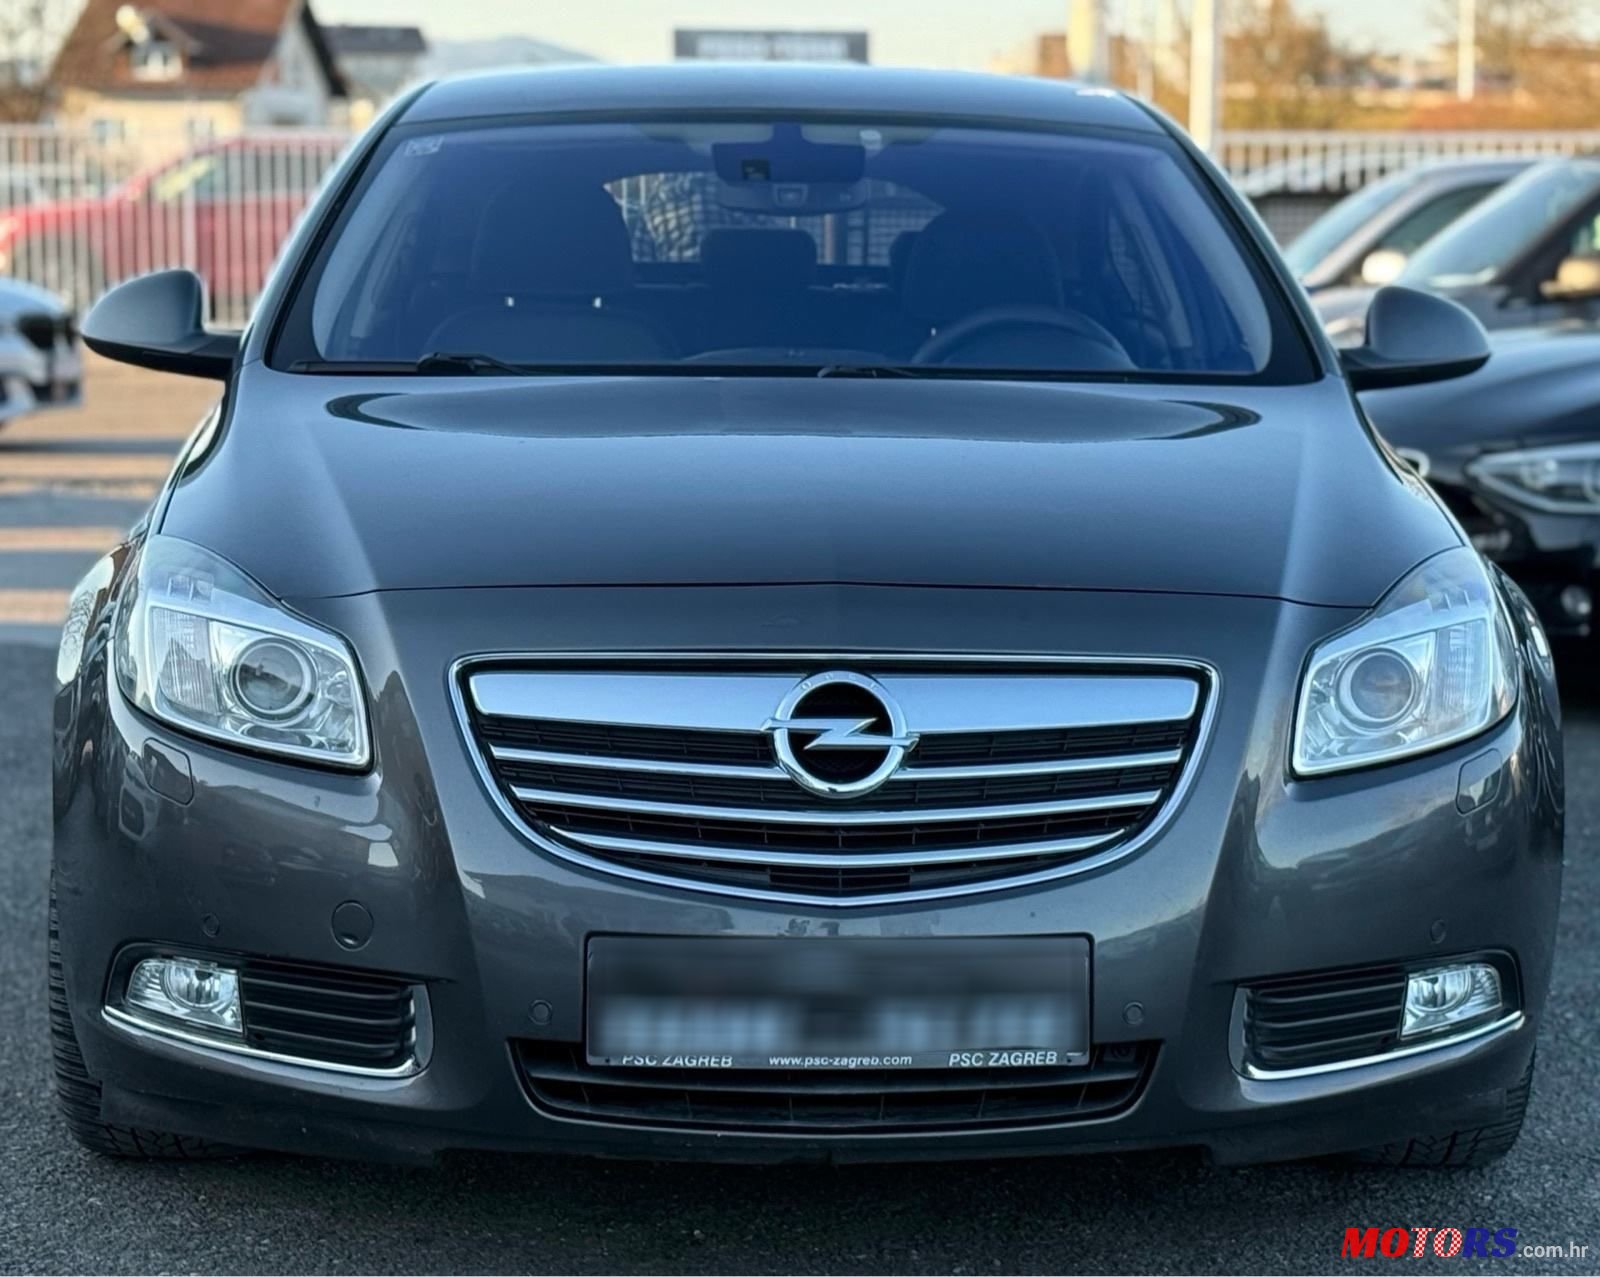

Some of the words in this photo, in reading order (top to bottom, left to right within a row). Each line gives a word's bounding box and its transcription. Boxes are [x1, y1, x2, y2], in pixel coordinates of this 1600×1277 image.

[768, 1055, 913, 1068] www.psc-zagreb.com
[949, 1053, 984, 1066] PSC
[988, 1051, 1058, 1065] ZAGREB
